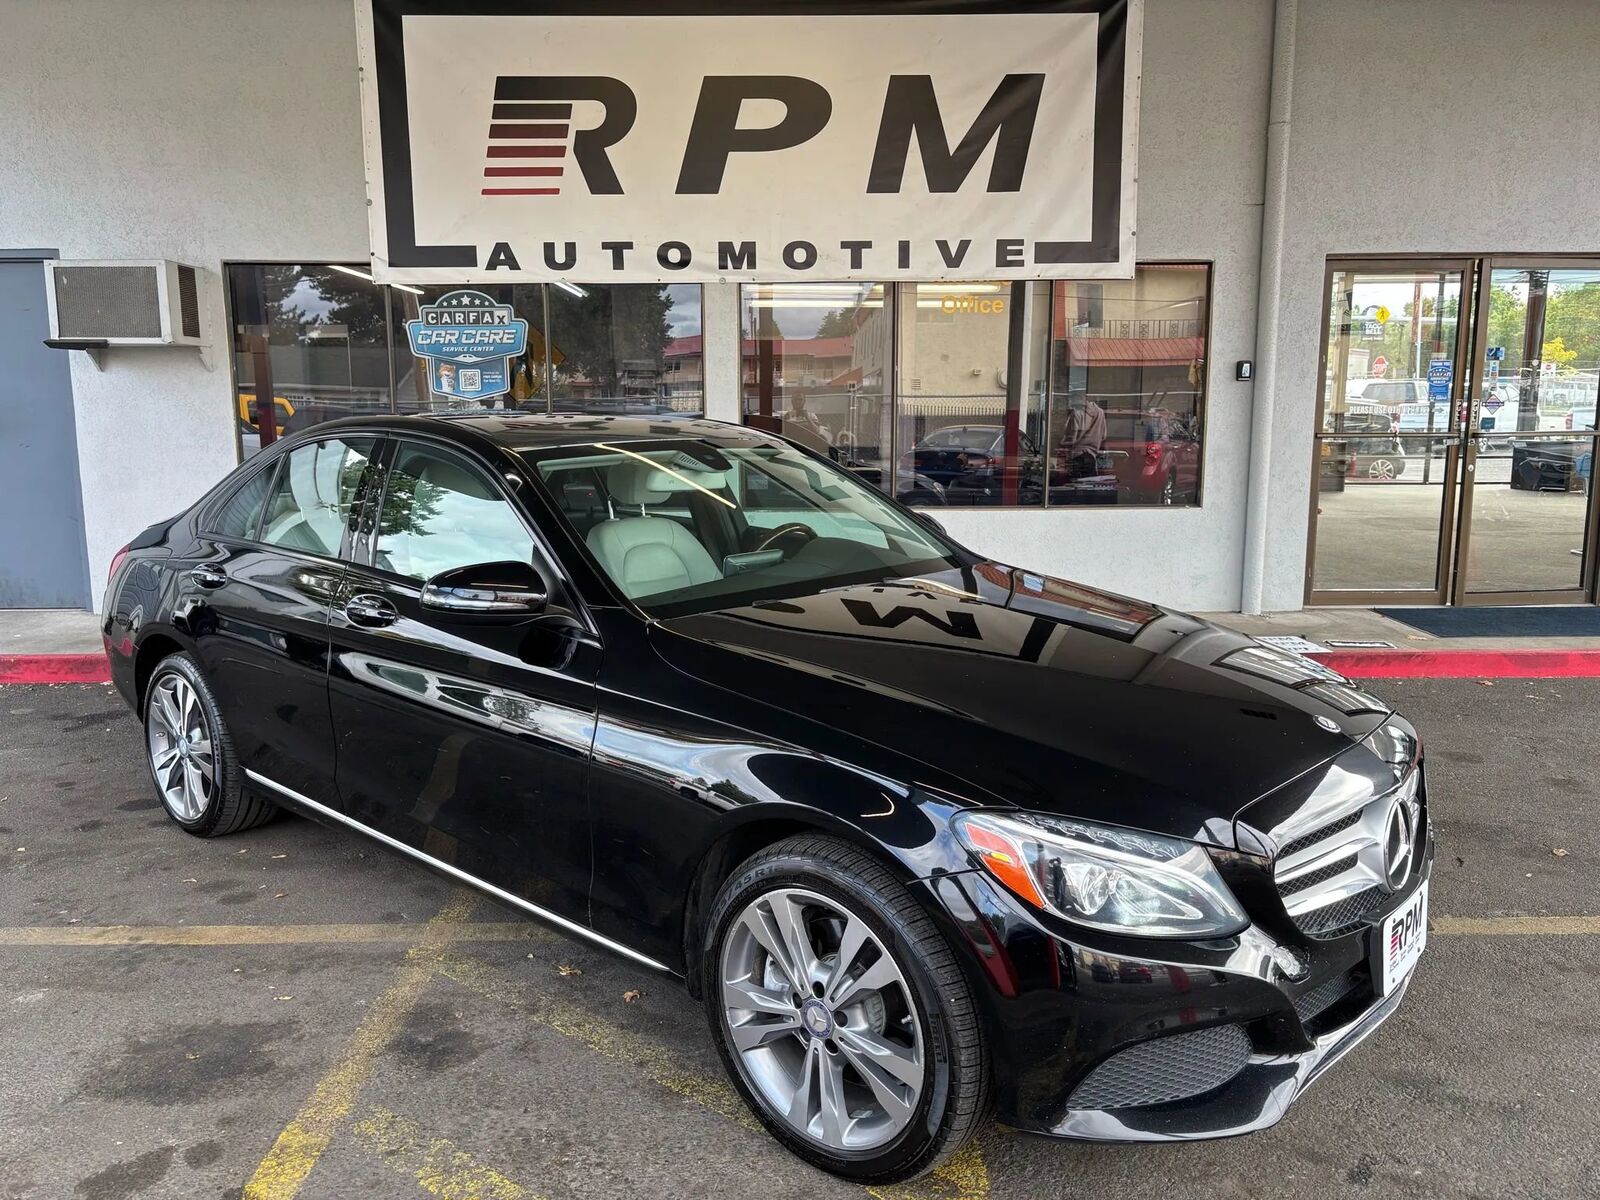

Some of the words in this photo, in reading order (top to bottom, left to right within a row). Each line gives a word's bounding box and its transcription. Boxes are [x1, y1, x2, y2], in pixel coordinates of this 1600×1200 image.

[481, 74, 1046, 195] RPM
[486, 238, 1026, 271] AUTOMOTIVE
[941, 295, 1004, 314] Office
[426, 312, 508, 325] CARFAX
[417, 329, 460, 344] CAR
[461, 329, 516, 344] CARE
[1349, 406, 1373, 414] PLEASE
[1374, 406, 1387, 414] USE
[1389, 894, 1423, 961] RPM
